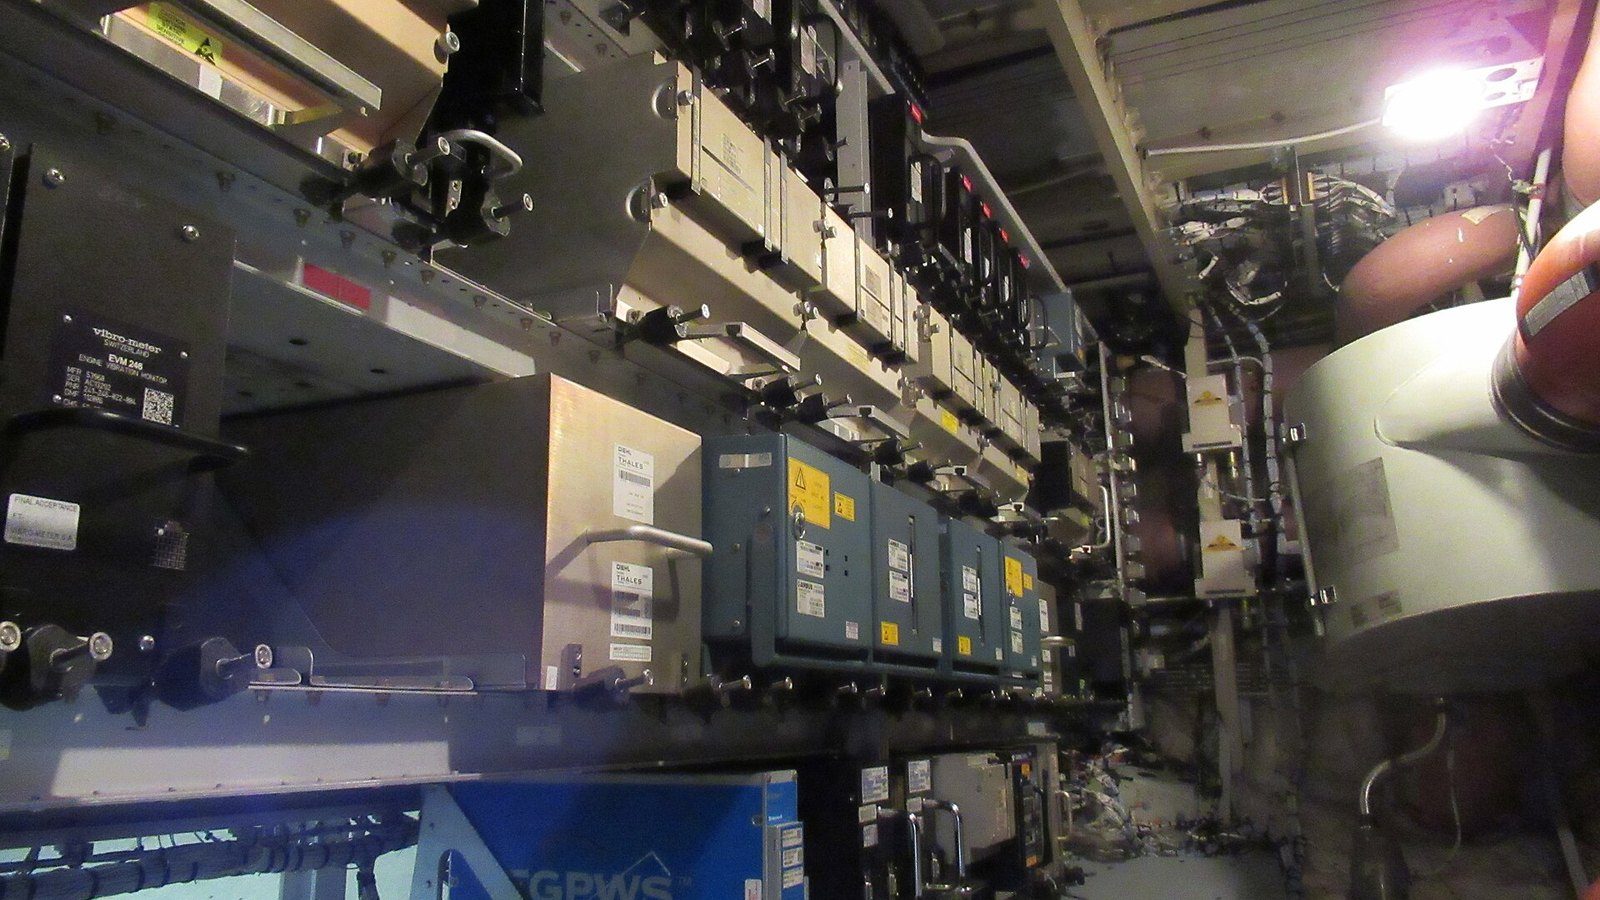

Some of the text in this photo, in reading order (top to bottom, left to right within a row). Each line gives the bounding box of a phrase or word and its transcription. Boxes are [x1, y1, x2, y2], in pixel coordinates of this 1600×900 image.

[104, 339, 150, 358] SWITZERLAND
[108, 353, 128, 367] EVM
[106, 362, 139, 377] VIBRATION
[140, 371, 168, 384] MONITOR
[618, 456, 644, 470] THALES
[14, 496, 78, 513] FINAL ACCEPTANCE
[616, 574, 643, 585] THALES
